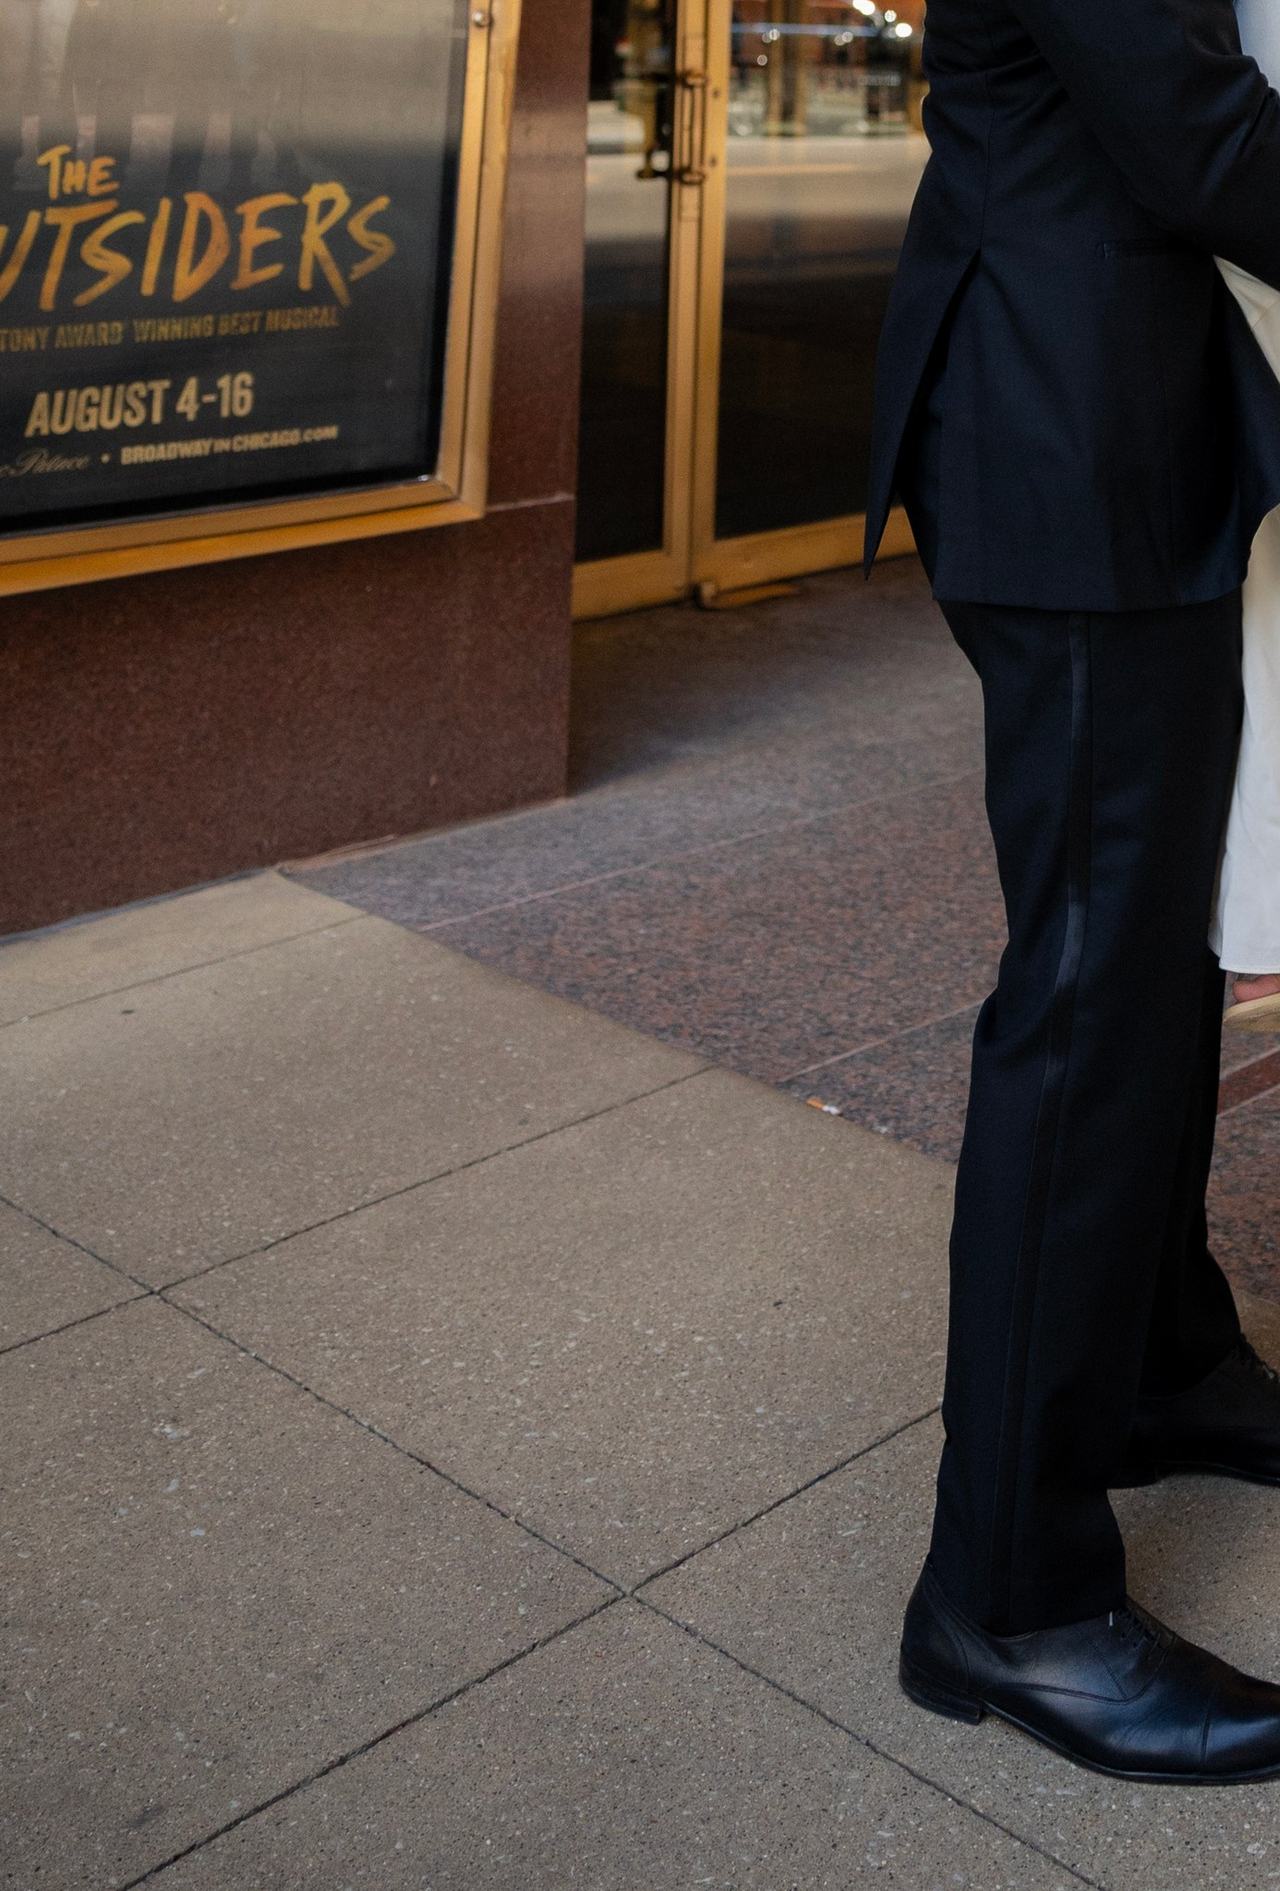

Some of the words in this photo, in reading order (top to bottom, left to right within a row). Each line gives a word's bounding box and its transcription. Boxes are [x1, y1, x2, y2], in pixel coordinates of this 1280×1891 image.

[36, 144, 120, 200] THE
[132, 314, 214, 344] WINNING
[218, 311, 262, 337] BEST
[264, 305, 340, 333] MUSICAL
[24, 378, 172, 439] AUGUST
[175, 371, 254, 423] 4-16
